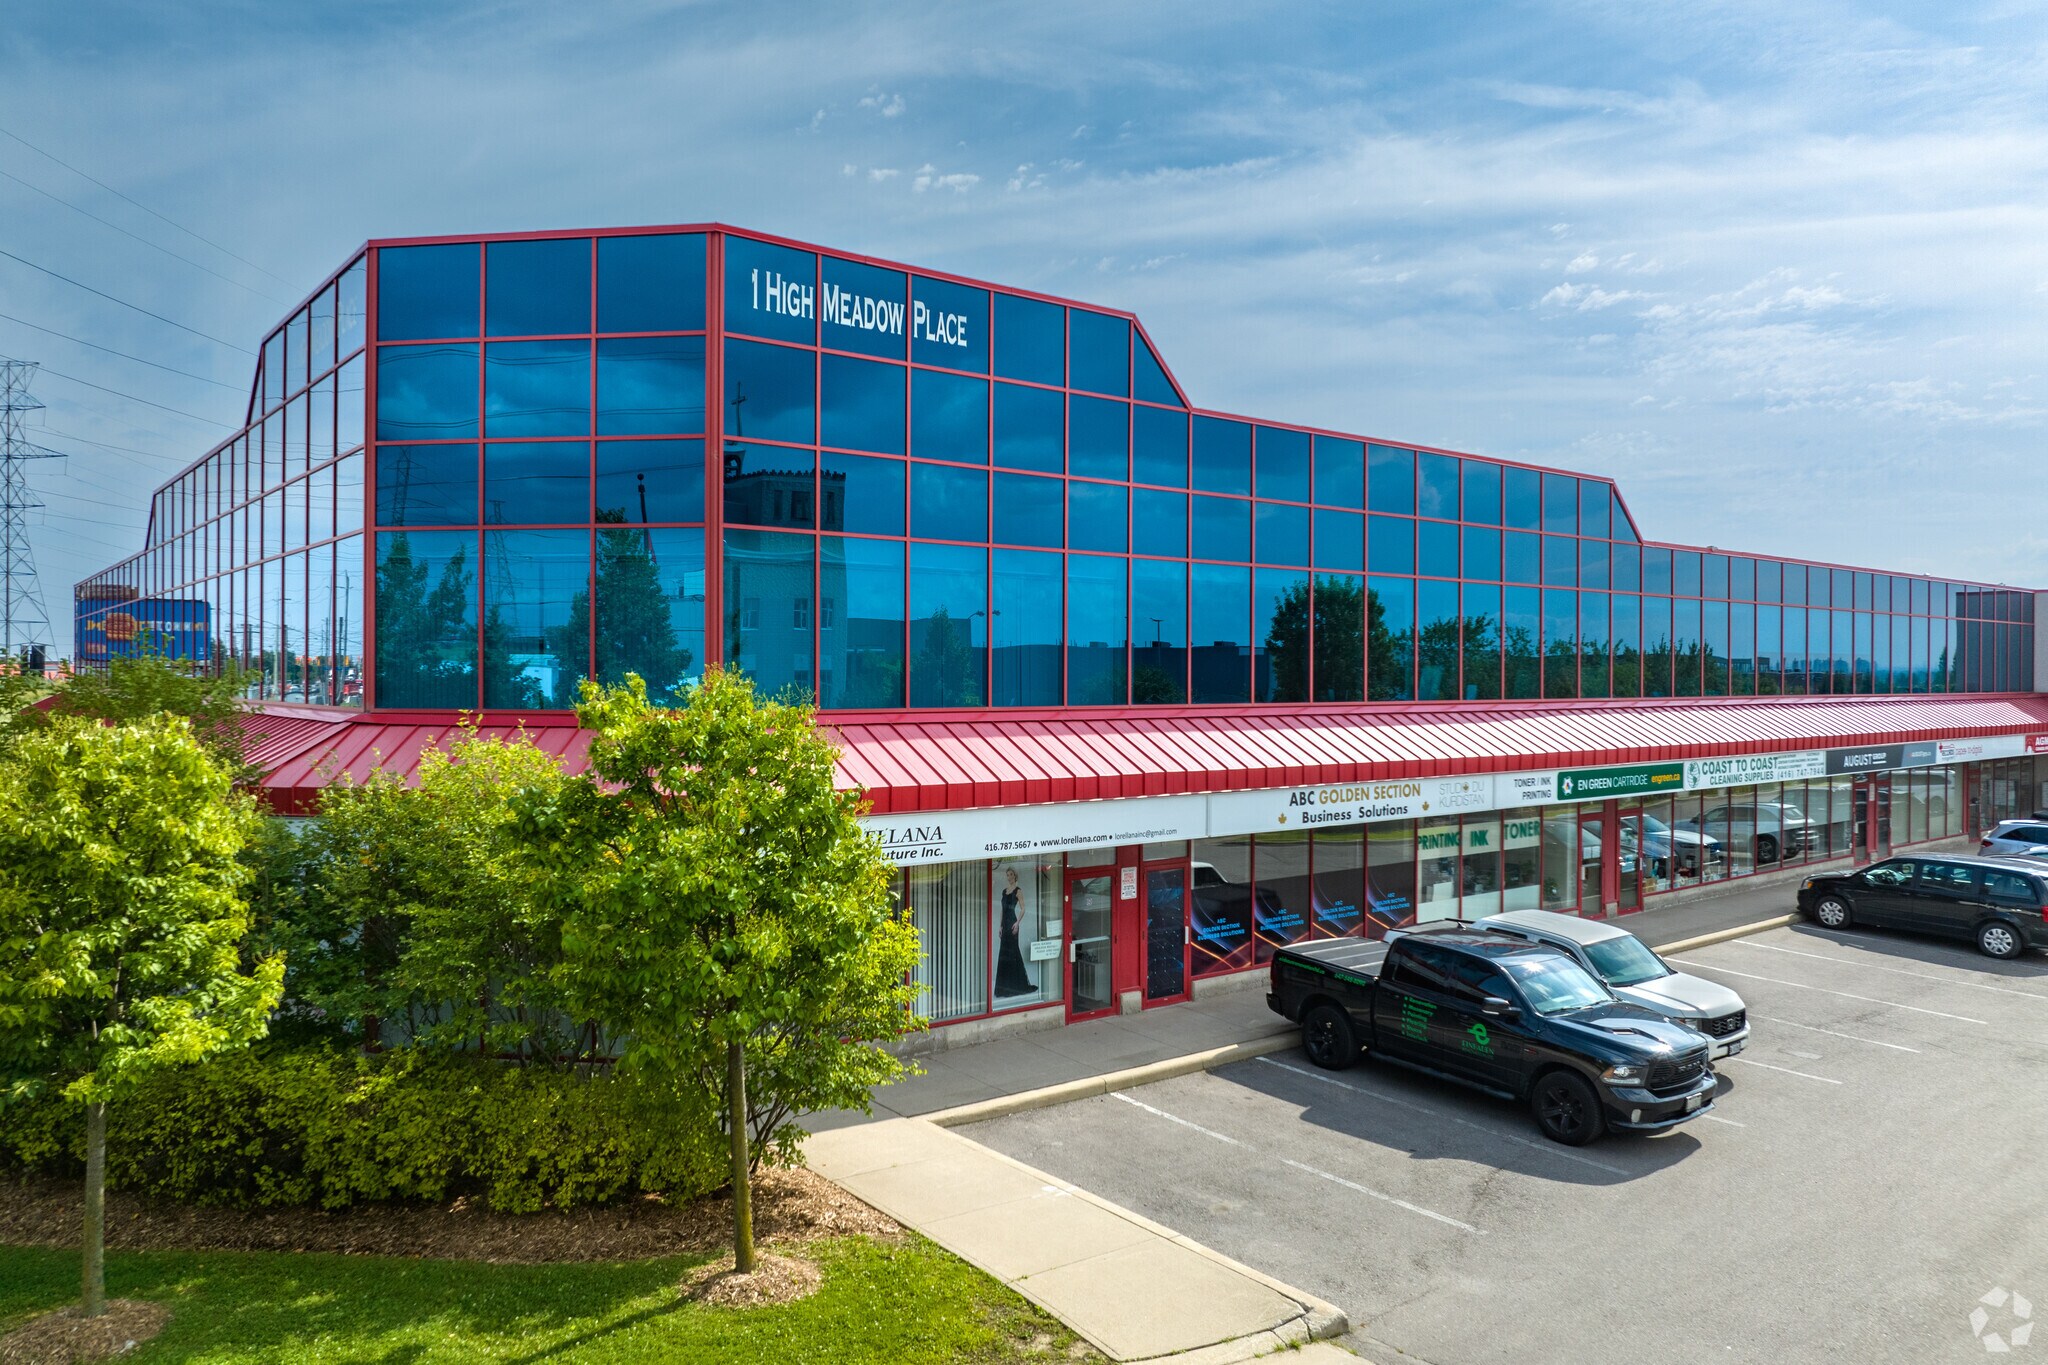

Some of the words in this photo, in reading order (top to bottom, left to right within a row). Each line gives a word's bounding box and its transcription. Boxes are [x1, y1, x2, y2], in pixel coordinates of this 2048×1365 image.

[752, 268, 758, 310] 1
[1702, 760, 1732, 775] COAST
[1735, 759, 1748, 772] TO
[1750, 756, 1778, 771] COAST
[1843, 754, 1873, 767] AUGUST
[1514, 777, 1536, 788] TONER
[1540, 777, 1551, 786] INK
[1578, 779, 1588, 791] EN
[1588, 777, 1613, 790] GREEN
[1613, 774, 1648, 787] CARTRIDGE
[1710, 774, 1744, 785] CLEANING
[1745, 771, 1774, 782] SUPPLIES
[1289, 791, 1315, 807] ABC
[1319, 786, 1370, 804] GOLDEN
[1374, 783, 1421, 800] SECTION
[1522, 789, 1552, 800] PRINTING
[1302, 810, 1352, 823] Business
[1358, 804, 1408, 818] Solutions
[1469, 829, 1489, 847] INK
[1503, 820, 1540, 840] TONER
[984, 840, 1032, 852] 416.787.5667
[1040, 834, 1108, 847] www.lorellana.com
[1114, 828, 1178, 840] lorellanainc@gmail.com
[1417, 831, 1460, 850] PRINTING
[921, 846, 944, 858] Inc.
